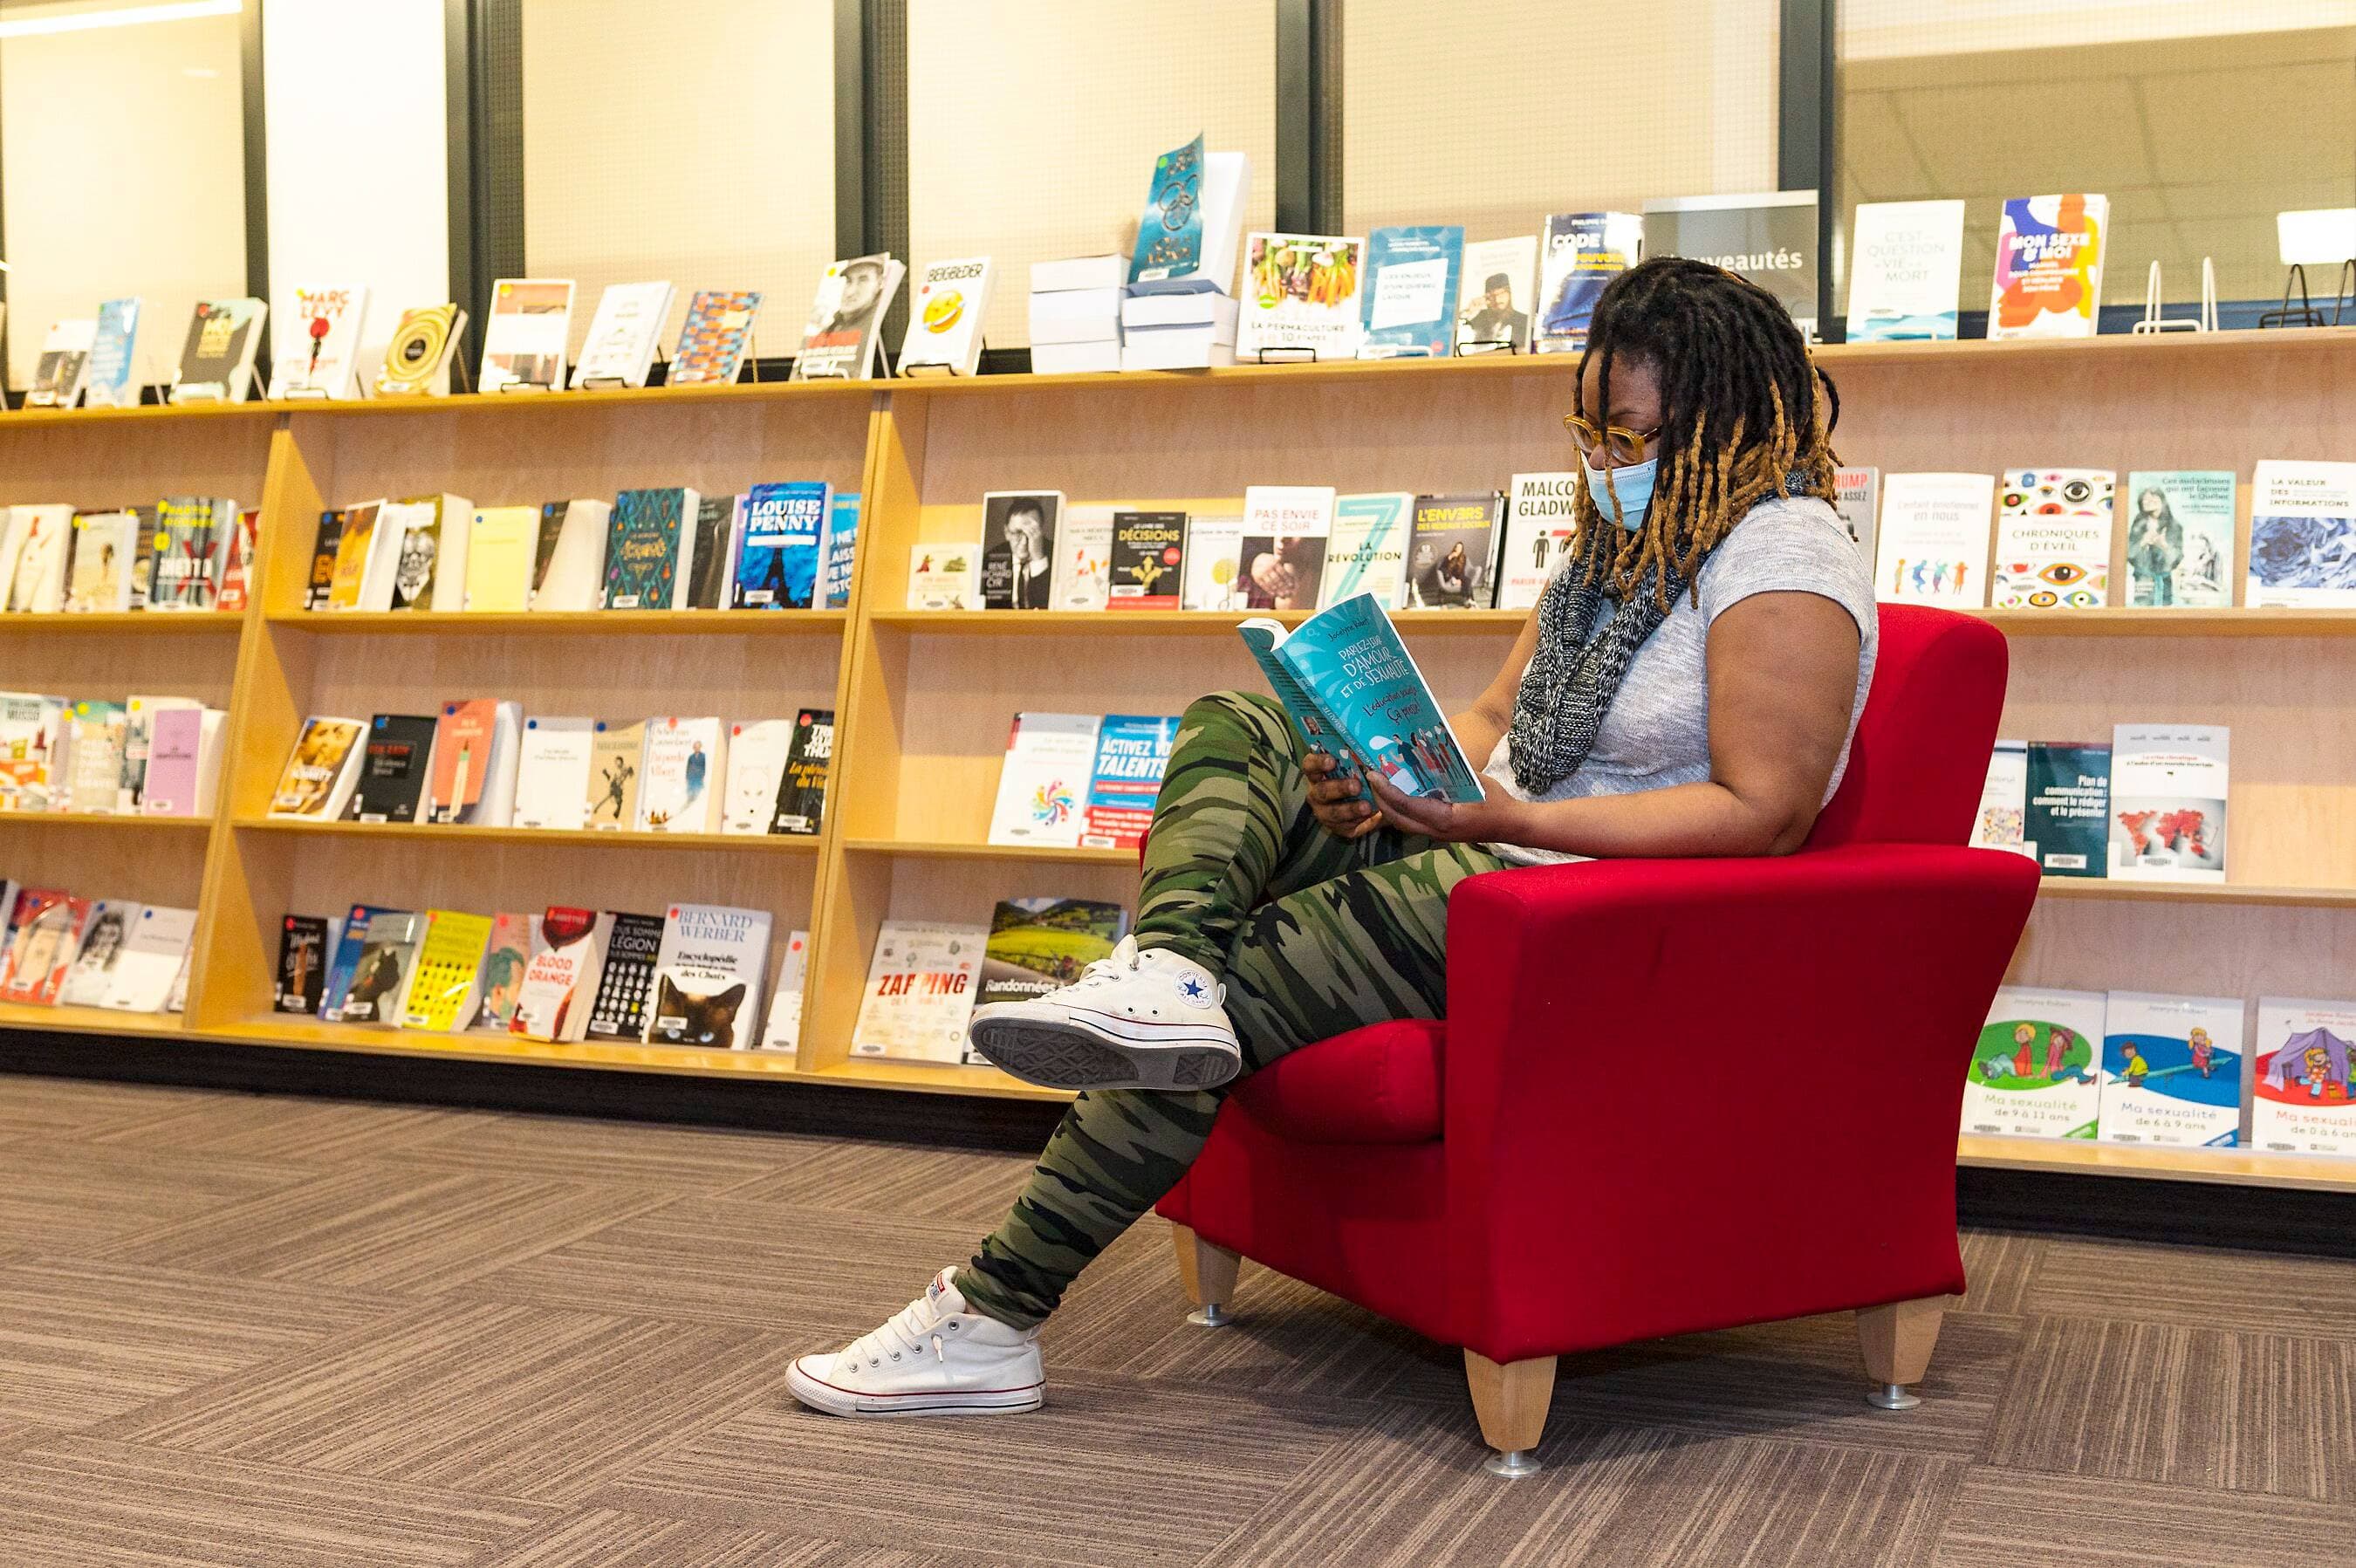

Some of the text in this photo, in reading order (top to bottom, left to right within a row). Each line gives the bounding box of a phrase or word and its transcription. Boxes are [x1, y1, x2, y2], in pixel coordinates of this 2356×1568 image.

[1551, 233, 1600, 250] CODE
[1522, 481, 1575, 496] MALCO
[1832, 474, 1867, 489] RUMP
[752, 499, 821, 517] LOUISE
[1255, 509, 1320, 519] PAS ENVIE
[1518, 501, 1572, 517] GLADW
[749, 515, 818, 532] PENNY
[1119, 527, 1180, 542] DÉCISIONS
[2012, 529, 2099, 540] CHRONIQUES
[1328, 551, 1401, 563] RÉVOLUTION
[1342, 647, 1392, 677] D'AMOUR
[1340, 683, 1353, 698] ET
[1353, 677, 1366, 690] DE
[1101, 739, 1152, 757] ACTIVEZ
[1097, 755, 1168, 779] TALENTS
[2079, 774, 2108, 787] Plan de
[2032, 796, 2106, 810] comment le rédiger
[2051, 806, 2106, 818] et le présenter
[678, 909, 753, 928] BERNARD
[681, 925, 746, 942] WERBER
[611, 933, 656, 953] LÉGION
[1985, 1094, 2078, 1111] Ma sexualité
[1995, 1107, 2009, 1116] de
[2012, 1109, 2019, 1118] 9
[2034, 1109, 2045, 1120] 11
[2049, 1113, 2071, 1122] ans
[2121, 1102, 2217, 1120] Ma sexualité
[2276, 1110, 2356, 1127] Ma sexuali
[2135, 1117, 2207, 1132] de 6 à 9 ans
[2291, 1125, 2306, 1134] de
[2332, 1126, 2339, 1137] 6
[2343, 1131, 2356, 1140] an
